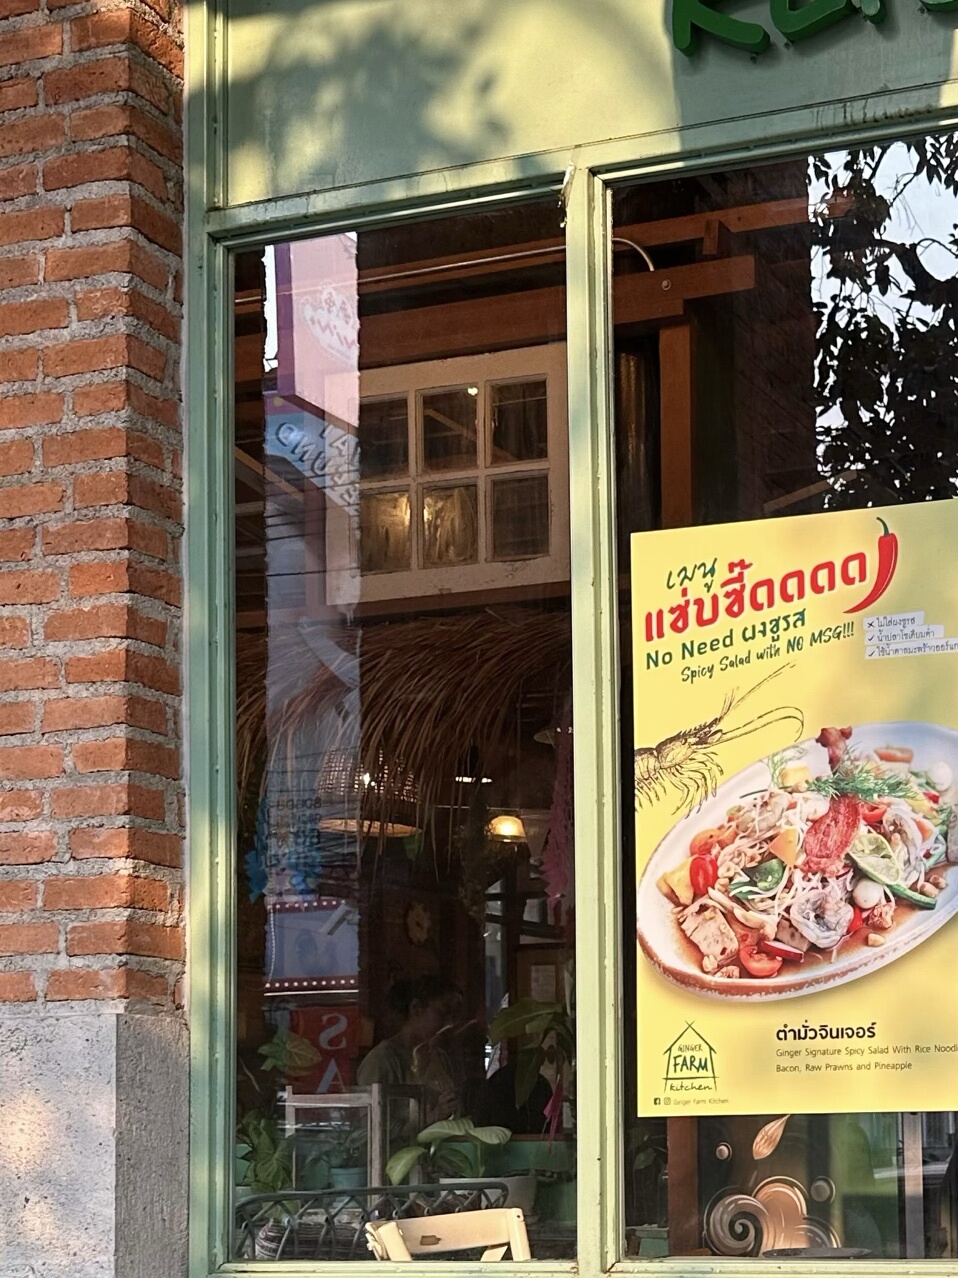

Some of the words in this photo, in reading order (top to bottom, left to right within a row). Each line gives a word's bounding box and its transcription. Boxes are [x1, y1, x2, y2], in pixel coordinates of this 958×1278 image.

[666, 557, 718, 593] เมนู
[646, 650, 673, 670] No
[681, 628, 734, 660] Need
[742, 608, 806, 643] ผงชูรส
[681, 664, 714, 684] Spicy
[720, 650, 751, 671] Salad
[756, 644, 780, 661] with
[810, 621, 854, 646] MSG!!!
[776, 1019, 877, 1041] ตำมั่วจินเจอร์
[678, 1044, 703, 1052] GINGER
[776, 1048, 802, 1058] Ginger
[805, 1048, 842, 1058] Signature
[844, 1046, 865, 1056] Spicy
[868, 1046, 889, 1054] Salad
[892, 1045, 912, 1054] With
[914, 1044, 931, 1053] Rice
[673, 1054, 708, 1074] FARM
[776, 1064, 802, 1073] Bacon,
[805, 1064, 822, 1072] Raw
[825, 1062, 853, 1071] Prawns
[856, 1062, 871, 1070] and
[874, 1060, 912, 1071] Pineapple
[670, 1081, 712, 1092] kitchen
